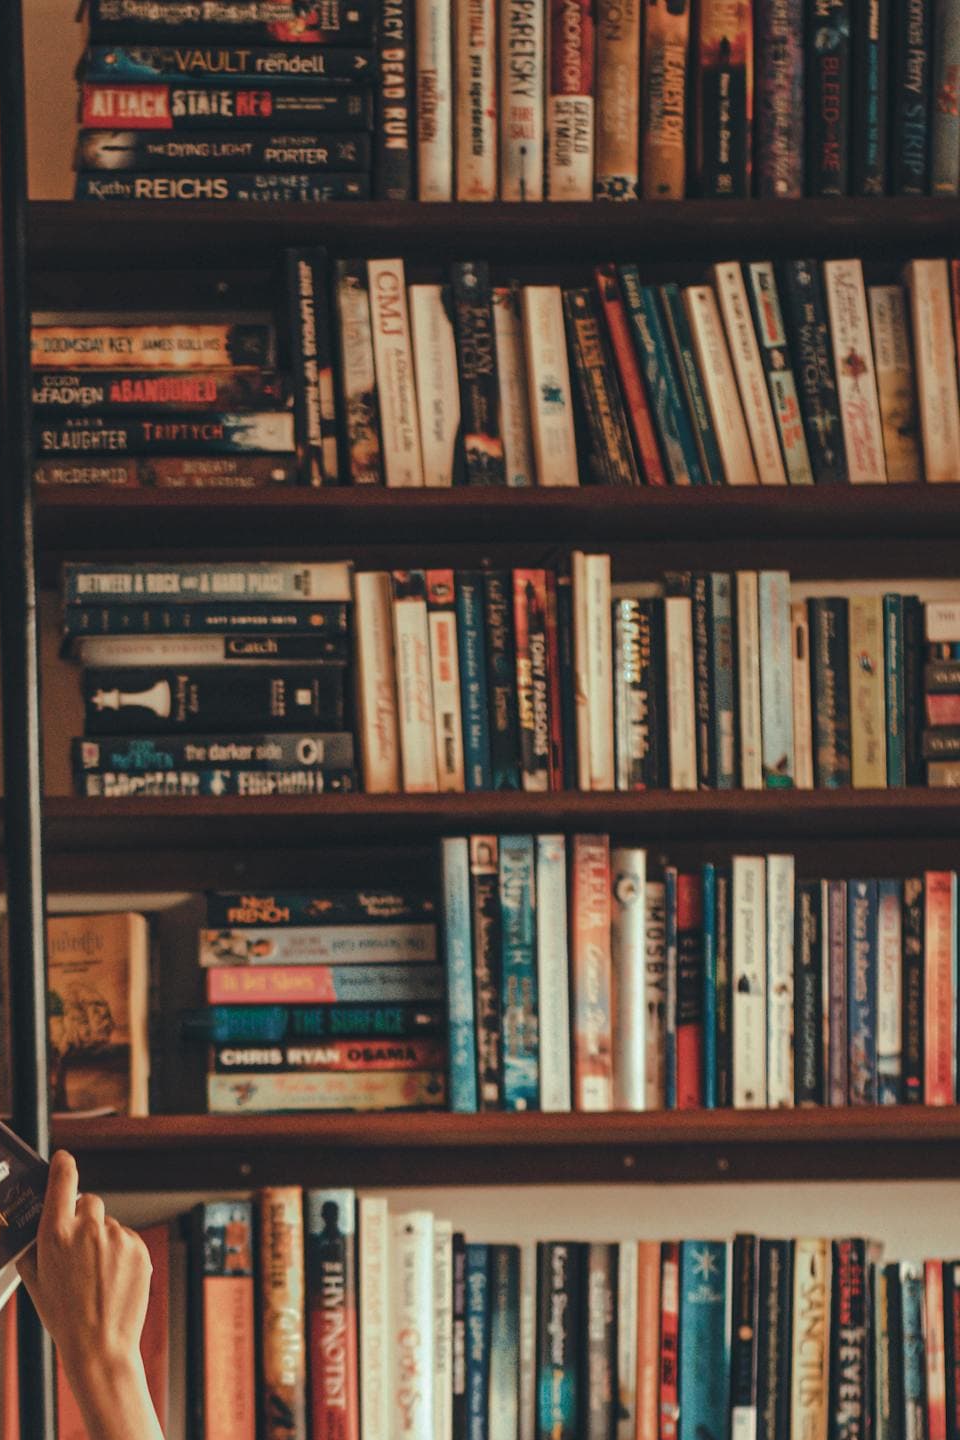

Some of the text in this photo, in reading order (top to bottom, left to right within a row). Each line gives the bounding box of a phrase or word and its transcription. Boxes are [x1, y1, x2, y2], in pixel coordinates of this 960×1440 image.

[174, 49, 326, 74] VAULT rendell
[382, 48, 406, 98] DEAD
[904, 48, 927, 94] Perry
[91, 88, 168, 118] ATTACK
[172, 90, 234, 117] STATE
[821, 56, 840, 172] BLEED ME
[168, 142, 210, 156] DYING
[213, 142, 254, 156] LIGHT
[384, 106, 408, 149] RUN
[553, 101, 572, 167] SEYMOUR
[573, 101, 589, 153] GERALD
[903, 104, 926, 176] STRIP
[264, 147, 329, 163] PORTER
[87, 178, 229, 198] Kathy REICHS
[375, 270, 404, 337] CMJ
[108, 335, 133, 353] KEY
[800, 323, 819, 395] WATCH
[108, 377, 218, 402] ABANDONED
[42, 421, 225, 450] SLAUGHTER TRIPTYCH
[76, 573, 133, 593] BETWEEN
[146, 573, 180, 593] ROCK
[228, 638, 279, 655] Catch
[531, 632, 550, 756] TONY PARSONS
[185, 743, 280, 760] the darker side
[227, 907, 290, 923] FRENCH
[645, 905, 665, 992] MOSBY
[220, 1048, 283, 1066] CHRIS
[287, 1047, 341, 1065] RYAN
[280, 1307, 302, 1386] fallen
[322, 1275, 348, 1411] HYPNOTIST
[800, 1283, 825, 1409] SANCTUS
[836, 1327, 863, 1418] FEVER
